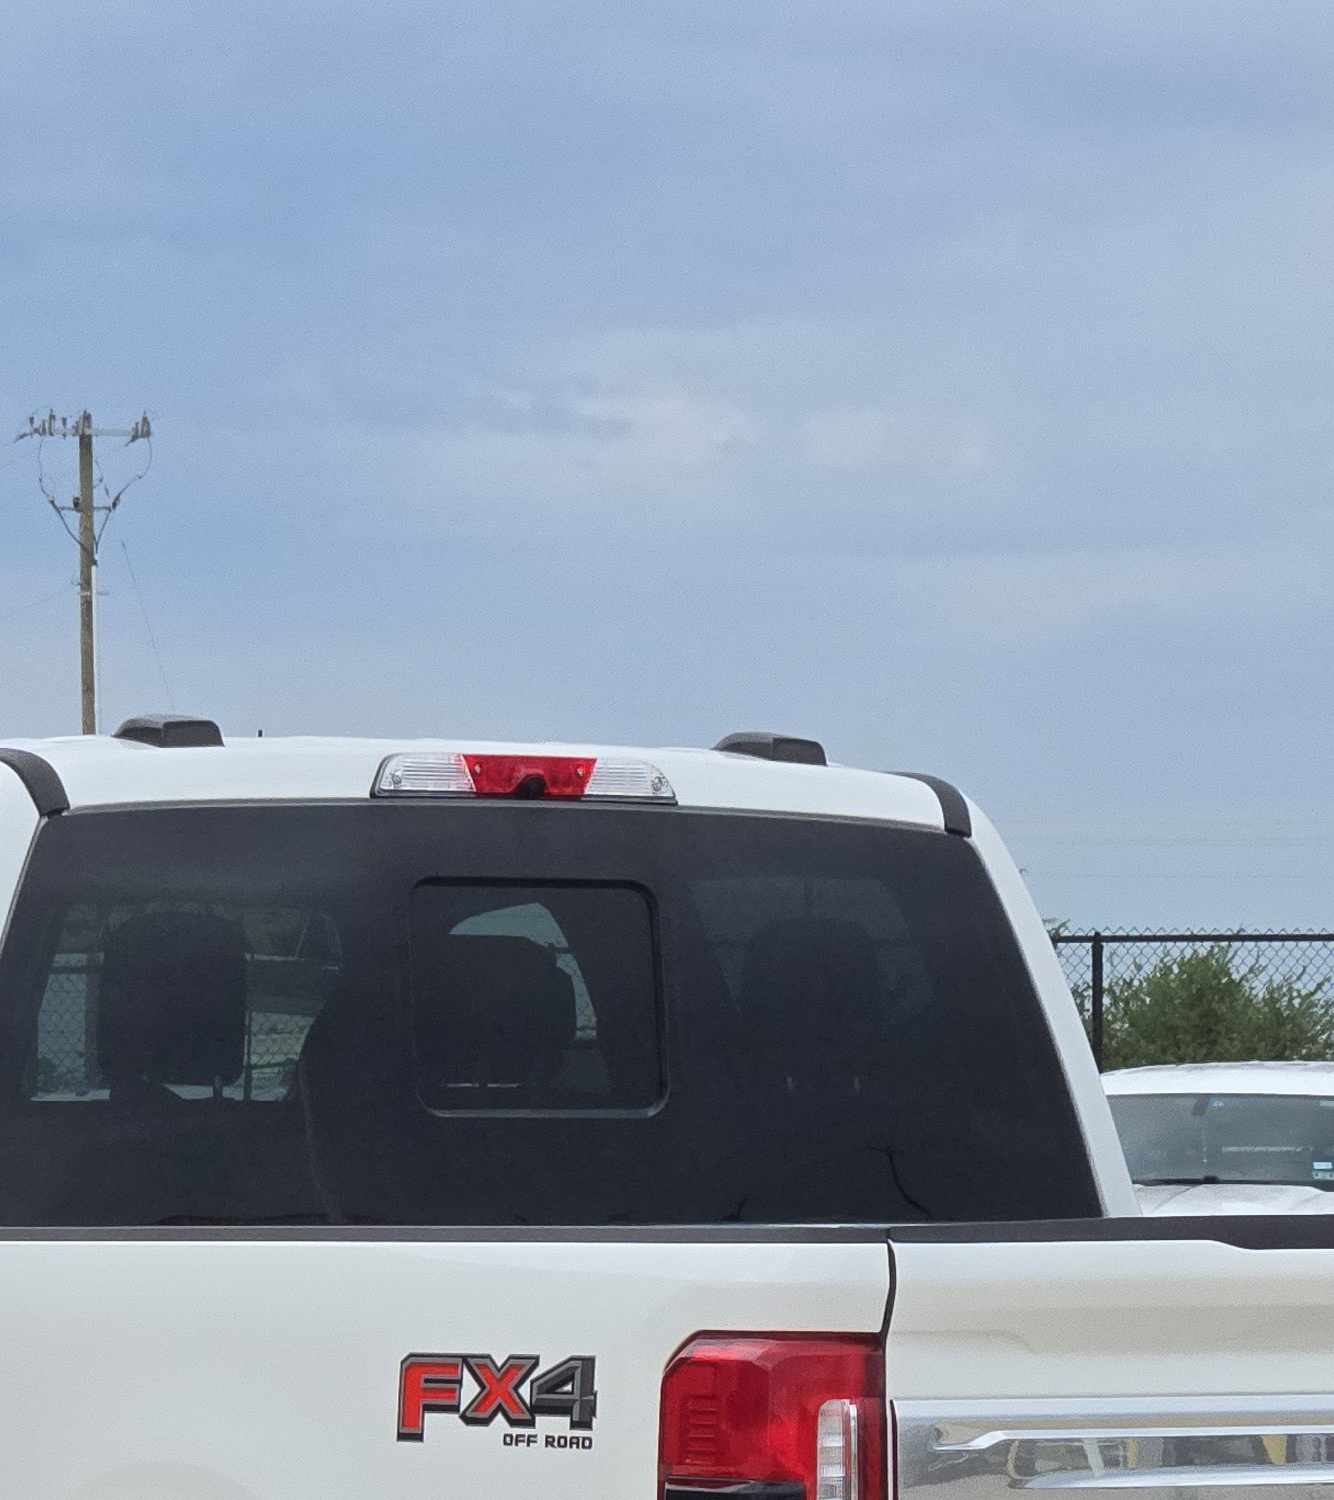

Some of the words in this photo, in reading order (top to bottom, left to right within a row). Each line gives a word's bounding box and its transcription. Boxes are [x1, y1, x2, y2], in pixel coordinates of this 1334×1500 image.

[396, 1352, 598, 1443] FX4
[502, 1433, 539, 1448] OFF
[544, 1434, 594, 1450] ROAD
